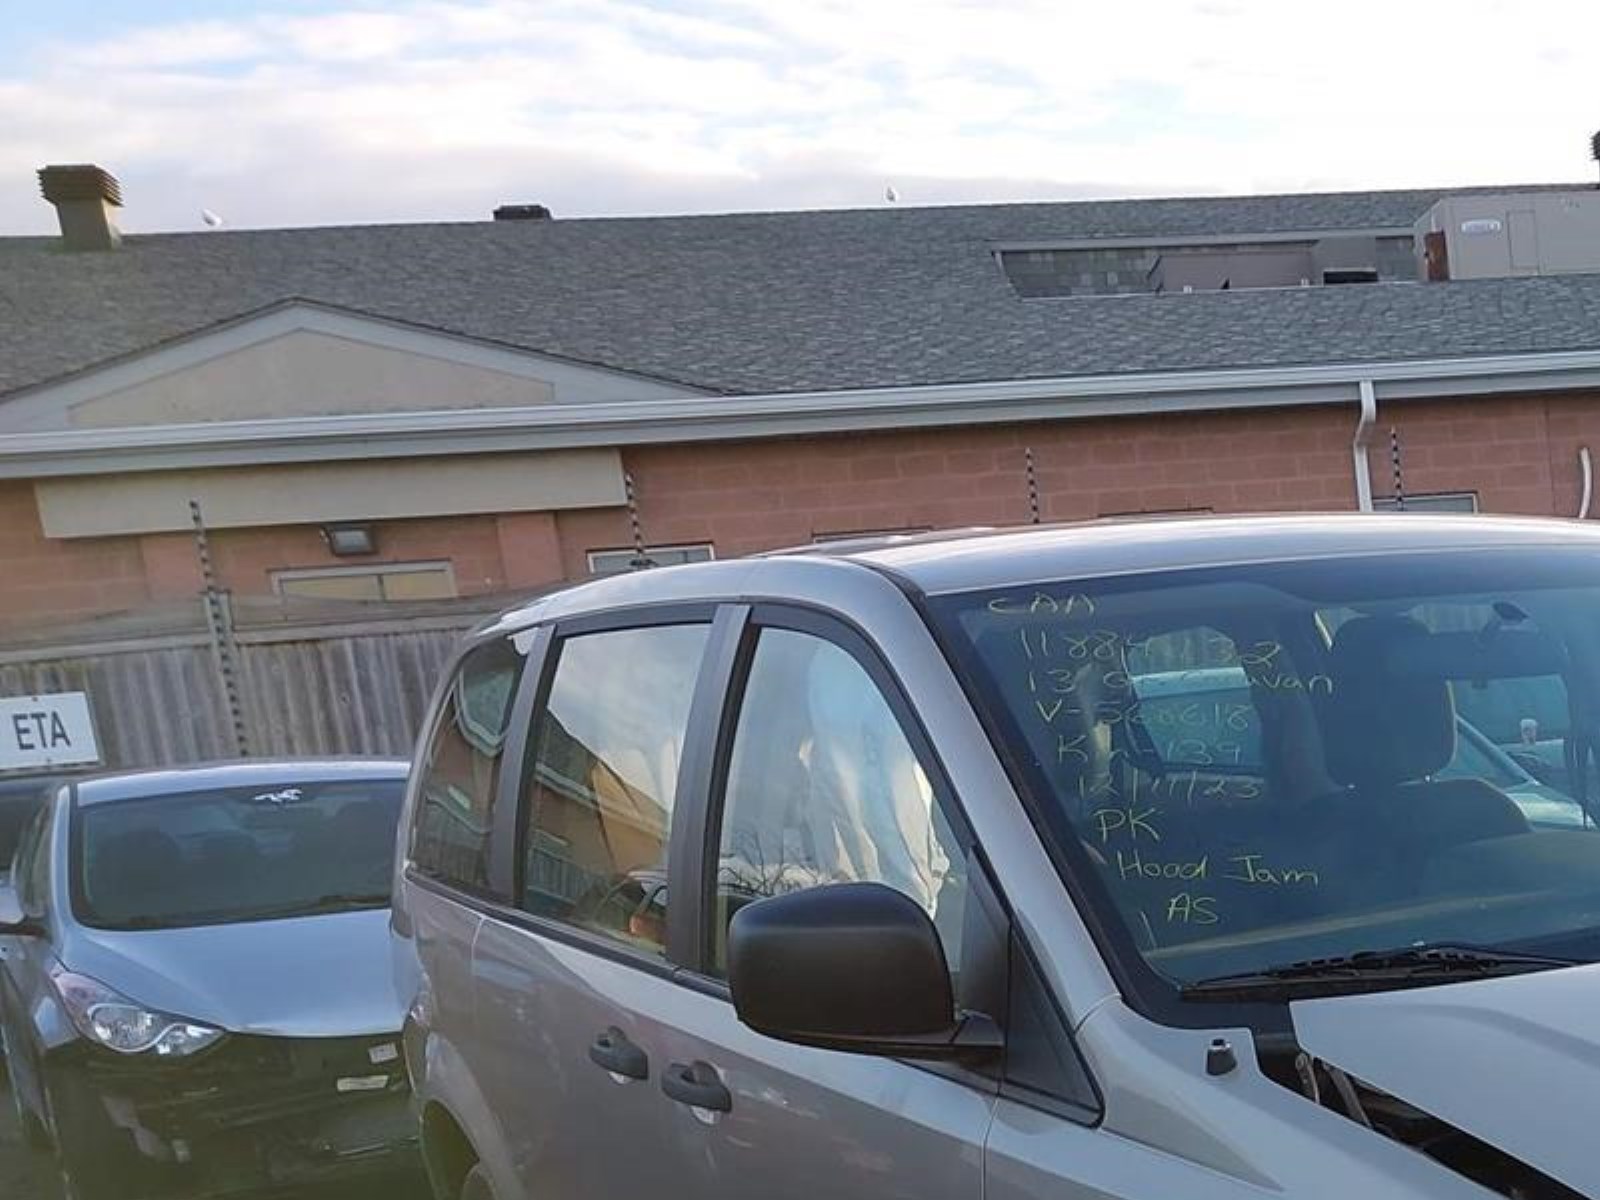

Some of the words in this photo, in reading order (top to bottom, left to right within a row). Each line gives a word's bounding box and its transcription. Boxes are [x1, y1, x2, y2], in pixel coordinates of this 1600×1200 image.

[12, 711, 71, 750] ETA
[1094, 807, 1160, 842] PK
[1117, 849, 1208, 880] Hood
[1224, 855, 1318, 886] Jam
[1167, 893, 1219, 924] AS
